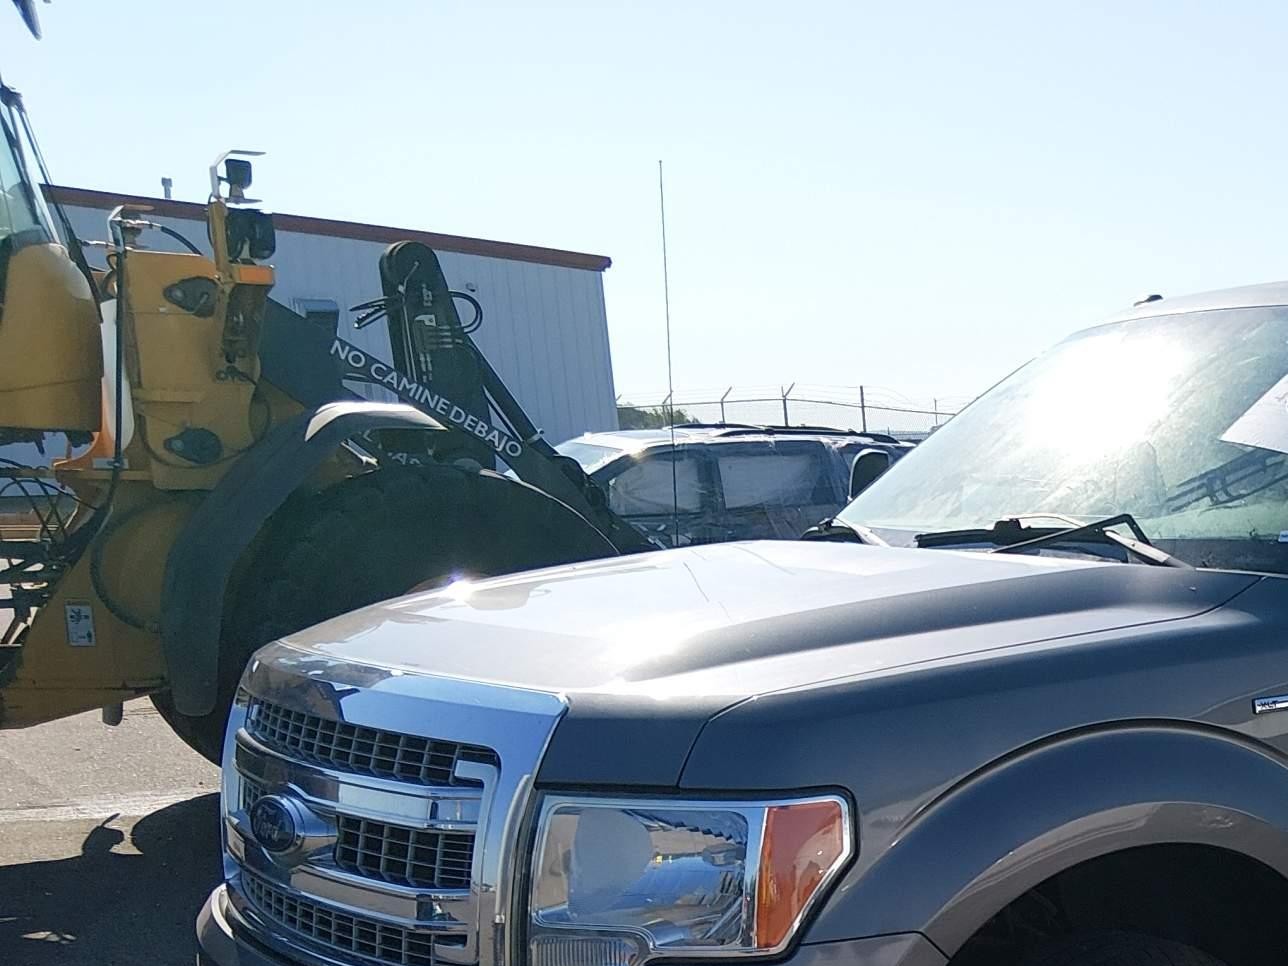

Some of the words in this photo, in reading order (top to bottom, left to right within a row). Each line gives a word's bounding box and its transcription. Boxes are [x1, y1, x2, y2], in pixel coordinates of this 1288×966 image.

[330, 340, 365, 367] NO
[371, 364, 450, 415] CAMINE
[449, 405, 522, 457] DEBAJO
